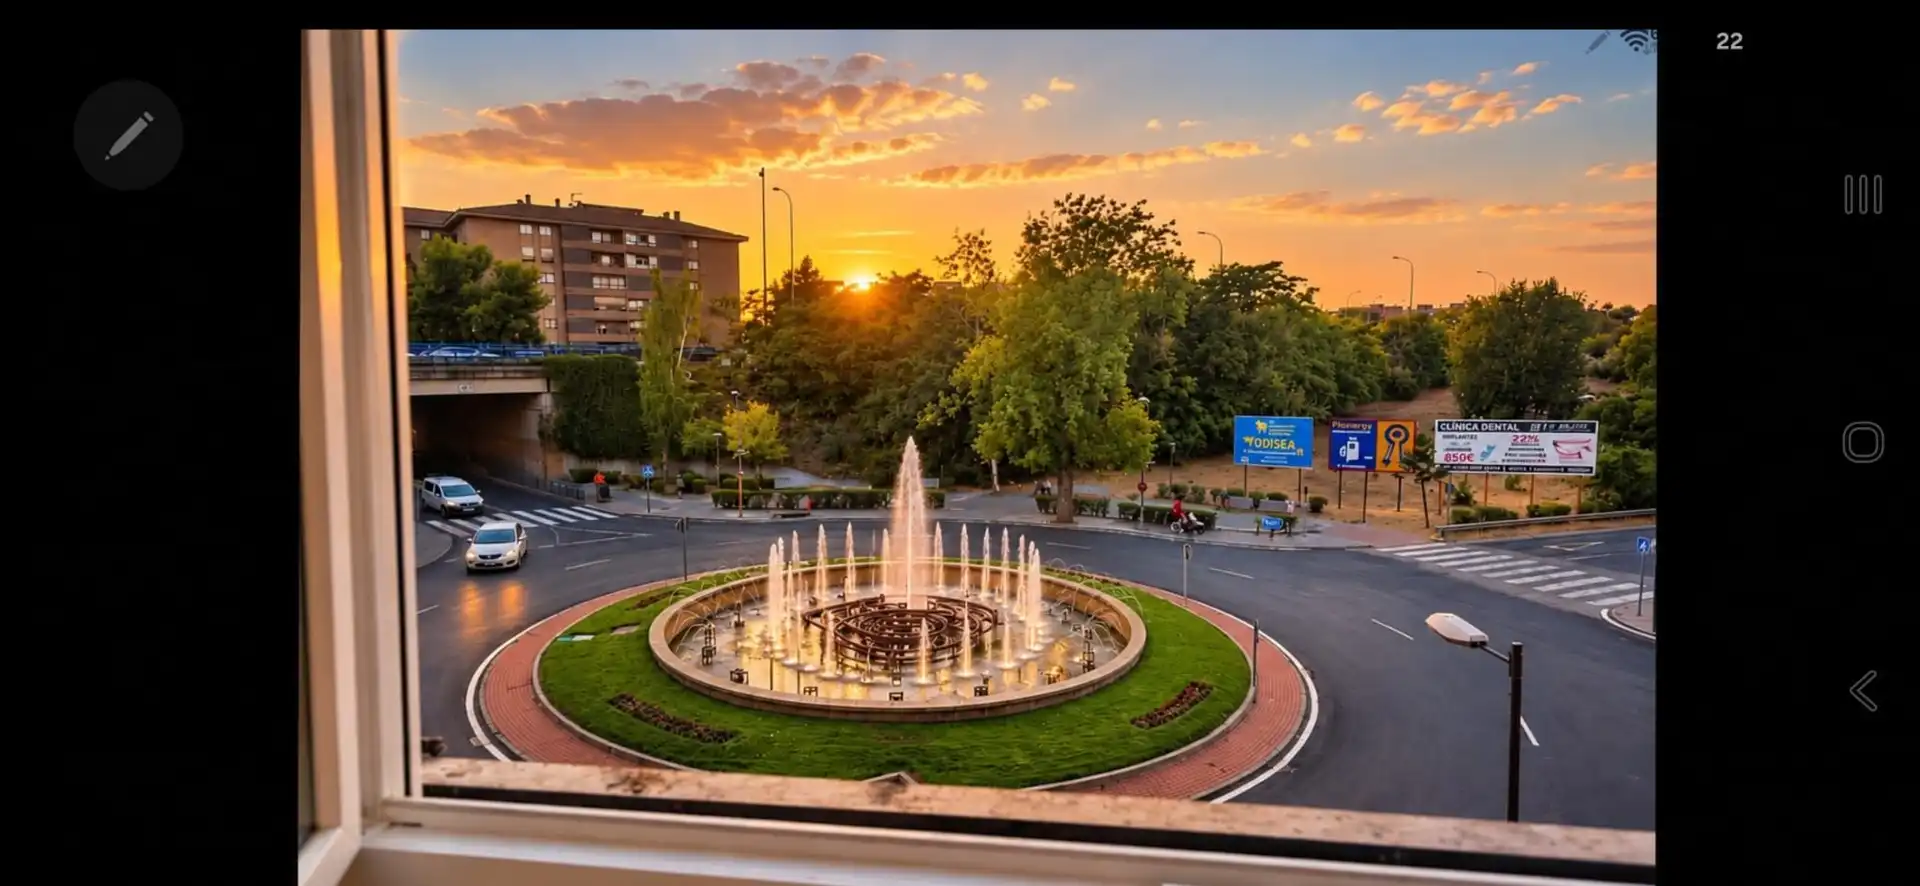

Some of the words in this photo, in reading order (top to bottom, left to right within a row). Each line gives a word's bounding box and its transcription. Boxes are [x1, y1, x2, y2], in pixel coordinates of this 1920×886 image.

[1440, 422, 1479, 431] CLÍNICA
[1481, 423, 1519, 431] DENTAL
[1444, 453, 1475, 463] 850€
